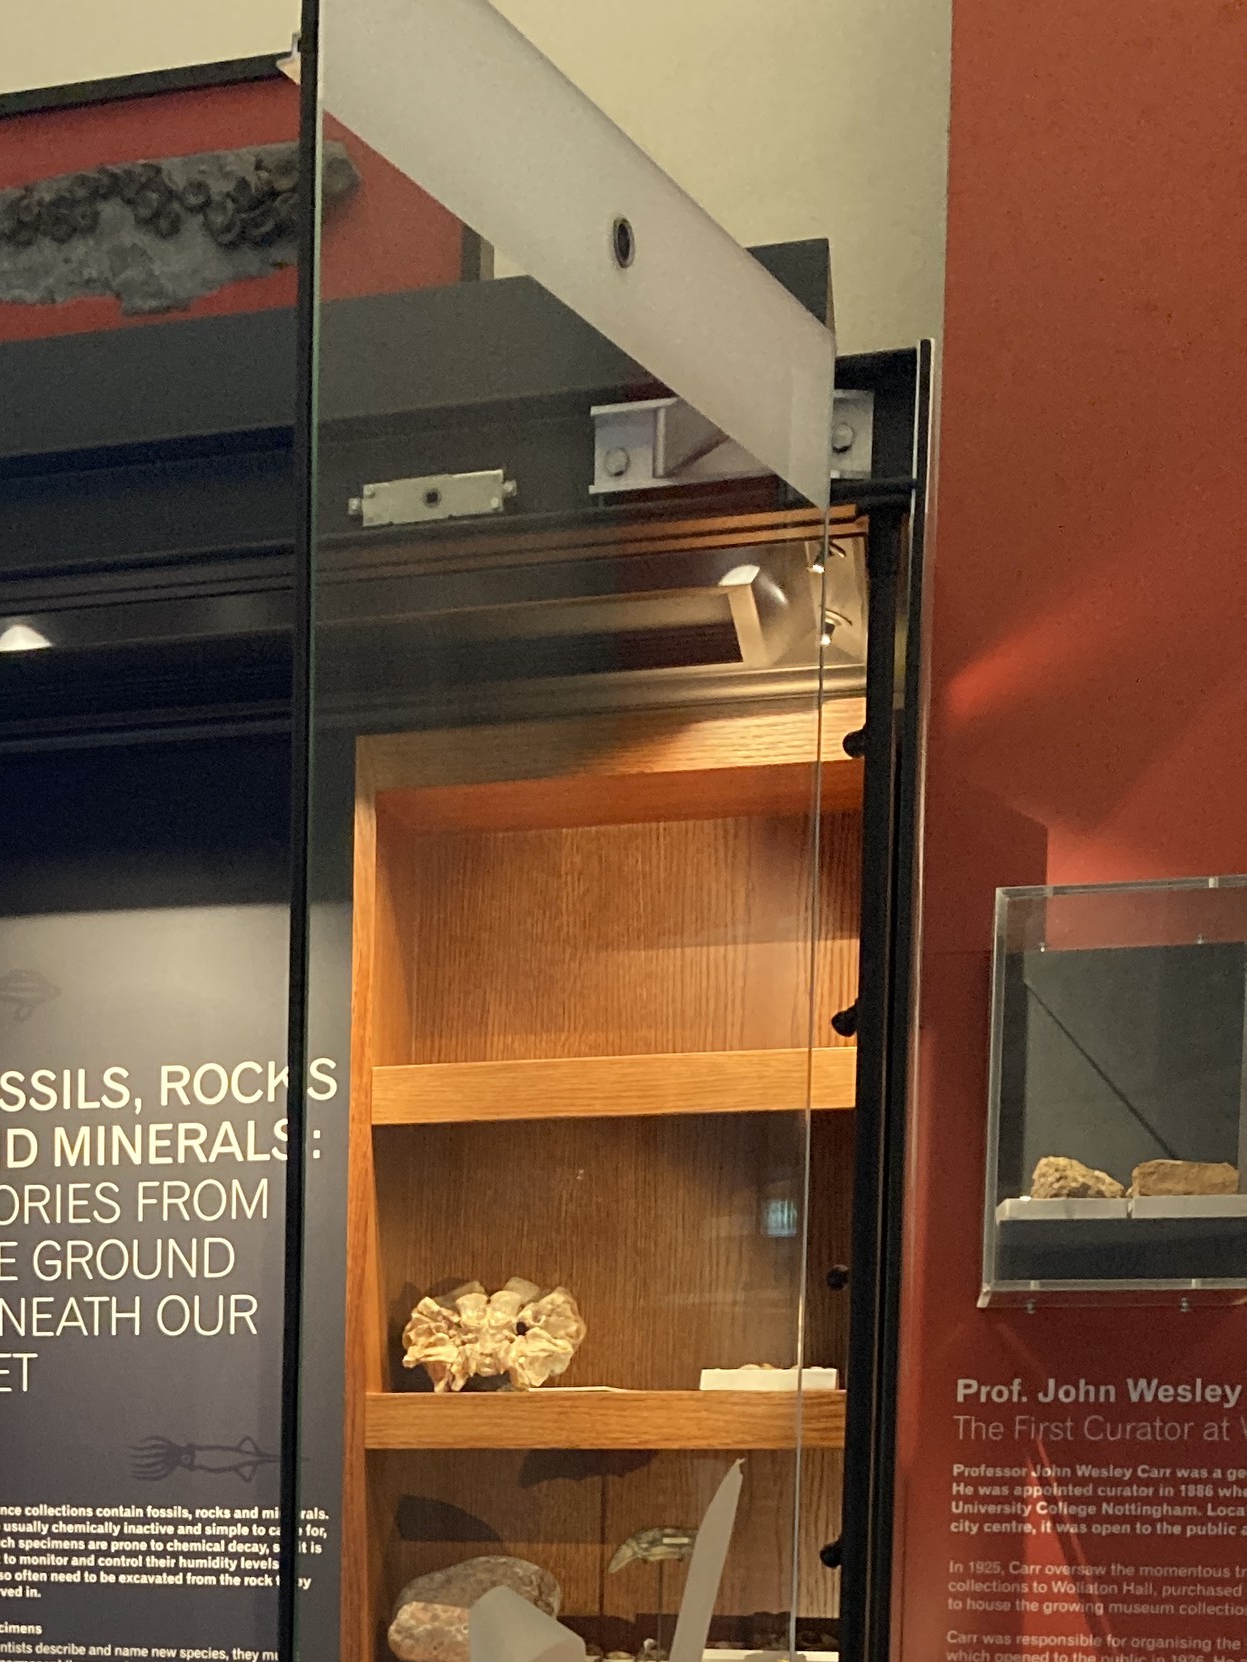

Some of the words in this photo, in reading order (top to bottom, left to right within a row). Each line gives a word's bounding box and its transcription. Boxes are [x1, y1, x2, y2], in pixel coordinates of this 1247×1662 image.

[160, 1057, 338, 1107] ROCKS
[137, 1178, 268, 1222] FROM
[33, 1237, 236, 1281] GROUND
[156, 1294, 258, 1336] OUR
[956, 1377, 1028, 1402] Prof.
[1037, 1377, 1116, 1402] John
[1127, 1378, 1242, 1409] Wesley
[953, 1415, 1004, 1440] The
[1012, 1415, 1074, 1440] First
[1082, 1415, 1195, 1440] Curator
[1202, 1415, 1230, 1441] at
[952, 1463, 1027, 1476] Professor
[1031, 1463, 1071, 1477] John
[1074, 1463, 1133, 1480] Wesley
[1136, 1464, 1172, 1477] Carr
[1175, 1467, 1209, 1478] was
[1211, 1468, 1222, 1478] a
[951, 1481, 974, 1495] He
[977, 1485, 1010, 1495] was
[1012, 1482, 1094, 1499] appointed
[1096, 1482, 1154, 1496] curator
[1158, 1483, 1175, 1496] in
[23, 1503, 93, 1517] collections
[95, 1504, 144, 1517] contain
[145, 1504, 193, 1521] fossils,
[194, 1505, 231, 1518] rocks
[233, 1505, 259, 1519] and
[261, 1506, 329, 1520] mirals.
[951, 1499, 1033, 1517] University
[1035, 1500, 1097, 1518] College
[3, 1519, 49, 1536] usually
[51, 1519, 121, 1537] chemically
[123, 1521, 175, 1534] inactive
[175, 1521, 203, 1535] and
[203, 1522, 249, 1538] simple
[251, 1522, 267, 1535] to
[305, 1523, 327, 1540] for,
[949, 1518, 979, 1535] city
[1039, 1519, 1053, 1533] it
[1055, 1522, 1087, 1533] was
[1091, 1523, 1131, 1537] open
[1135, 1520, 1152, 1534] to
[1155, 1520, 1182, 1534] the
[1185, 1521, 1237, 1538] public
[17, 1535, 85, 1553] specimens
[87, 1539, 109, 1550] are
[109, 1540, 147, 1554] prone
[149, 1537, 165, 1551] to
[165, 1538, 225, 1552] chemical
[227, 1539, 270, 1556] decay,
[309, 1540, 323, 1553] is
[2, 1551, 17, 1565] to
[18, 1552, 69, 1566] monitor
[70, 1553, 95, 1566] and
[96, 1553, 143, 1567] control
[144, 1554, 176, 1568] their
[178, 1555, 238, 1572] humidity
[13, 1568, 48, 1581] often
[49, 1568, 81, 1582] need
[83, 1569, 97, 1583] to
[99, 1570, 116, 1583] be
[117, 1570, 183, 1584] excavated
[185, 1571, 217, 1585] from
[218, 1572, 242, 1586] the
[243, 1573, 274, 1586] rock
[25, 1584, 42, 1598] in.
[34, 1641, 86, 1655] describe
[87, 1642, 112, 1656] and
[113, 1646, 149, 1657] name
[150, 1647, 177, 1658] new
[179, 1645, 229, 1662] species,
